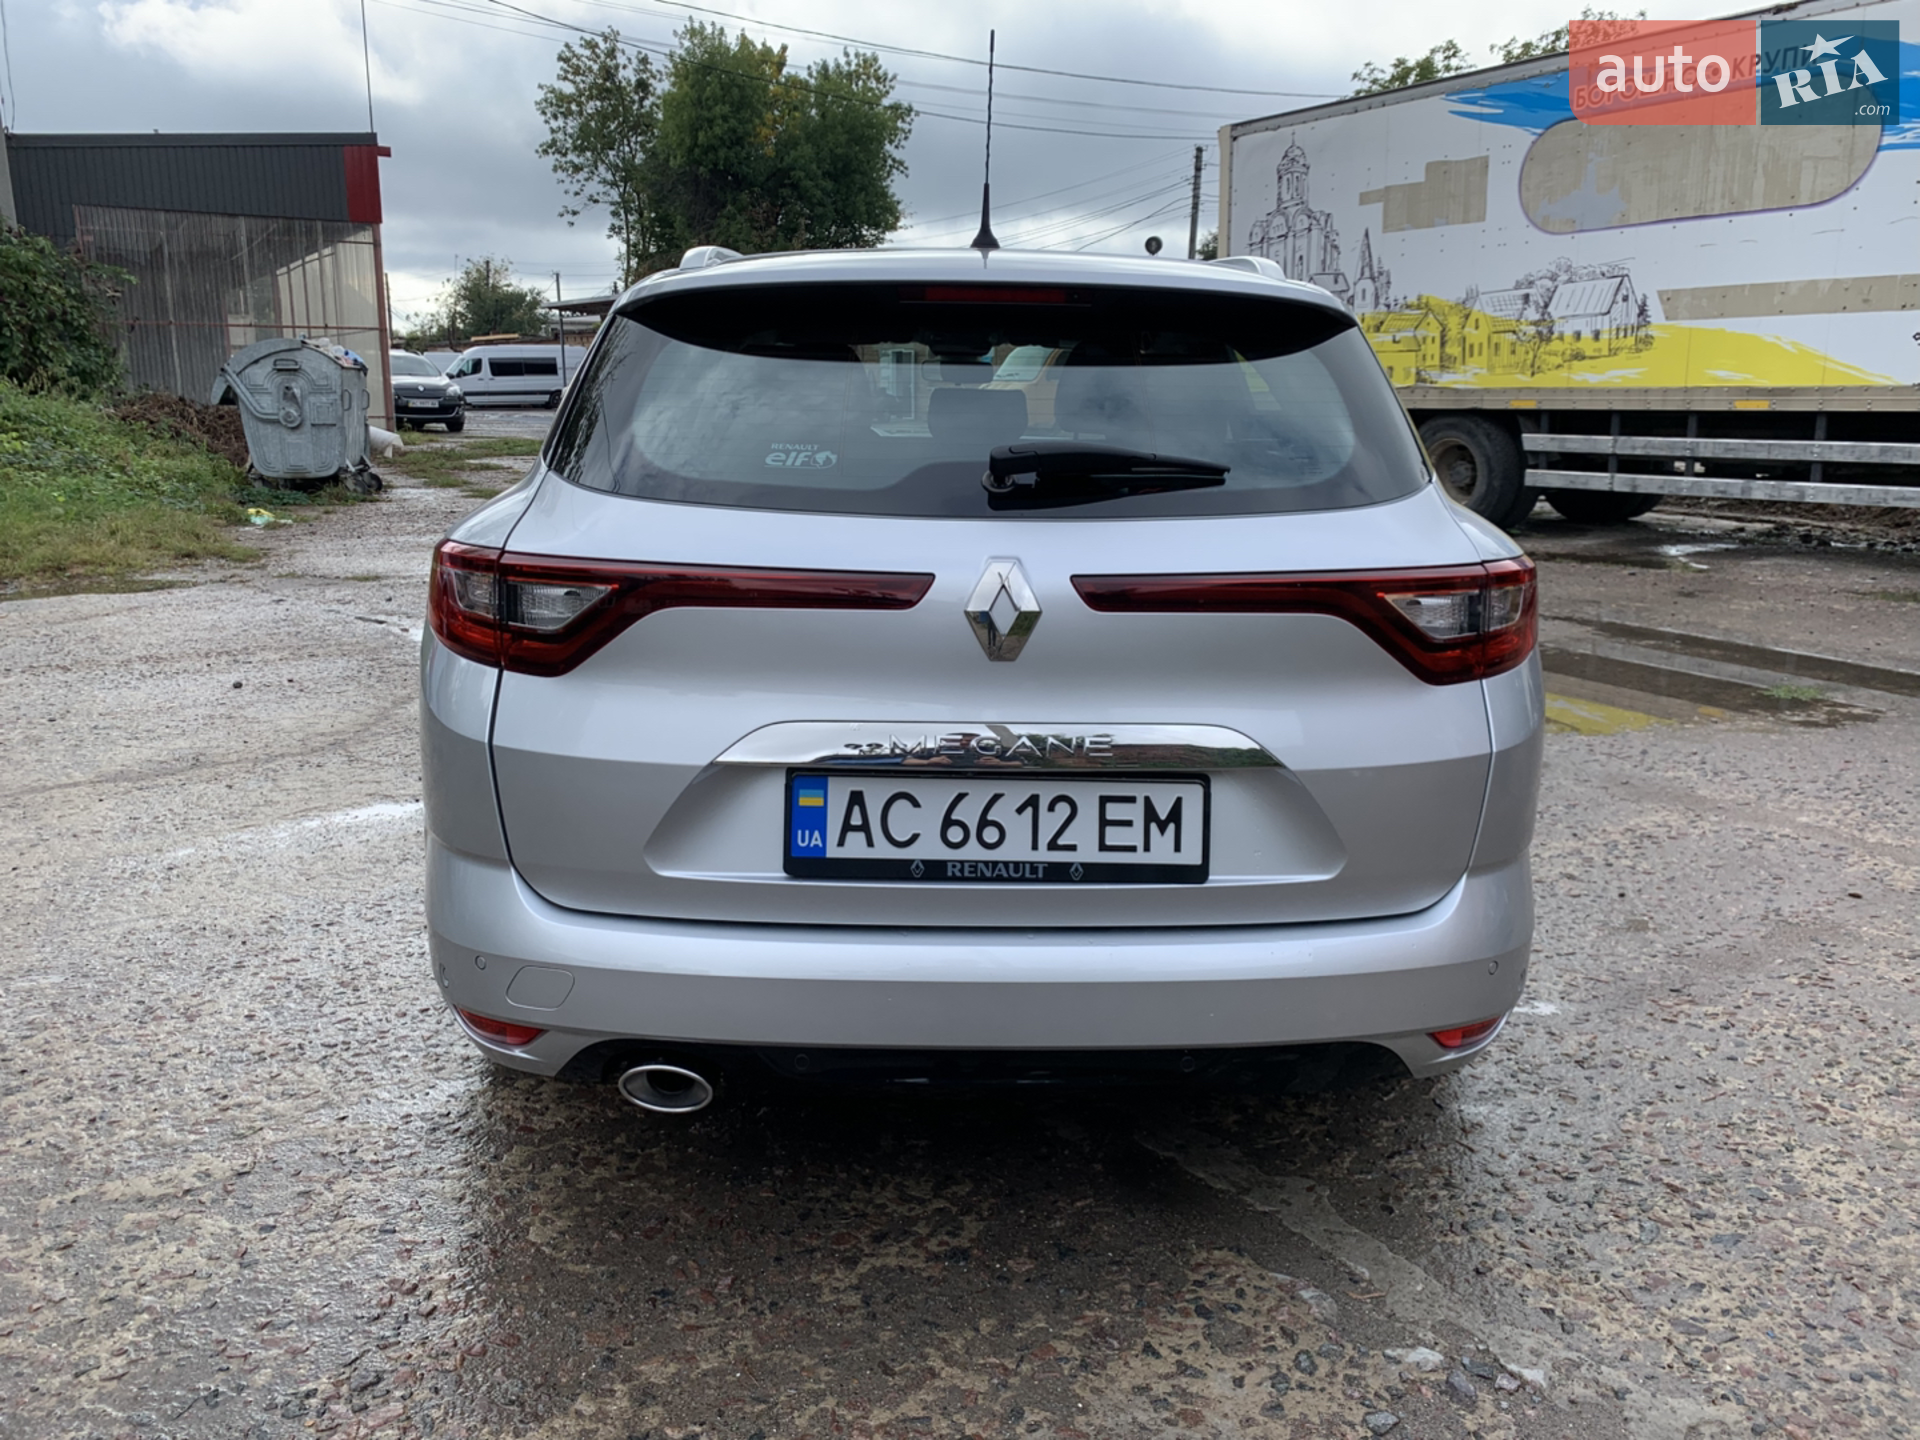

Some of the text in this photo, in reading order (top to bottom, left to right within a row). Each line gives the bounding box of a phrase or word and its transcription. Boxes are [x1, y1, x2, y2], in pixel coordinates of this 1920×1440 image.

[771, 443, 820, 451] RENAULT
[888, 734, 1114, 758] MEGANE
[837, 790, 1183, 853] AC 6612 EM
[797, 829, 823, 848] UA
[947, 862, 1048, 879] RENAULT
